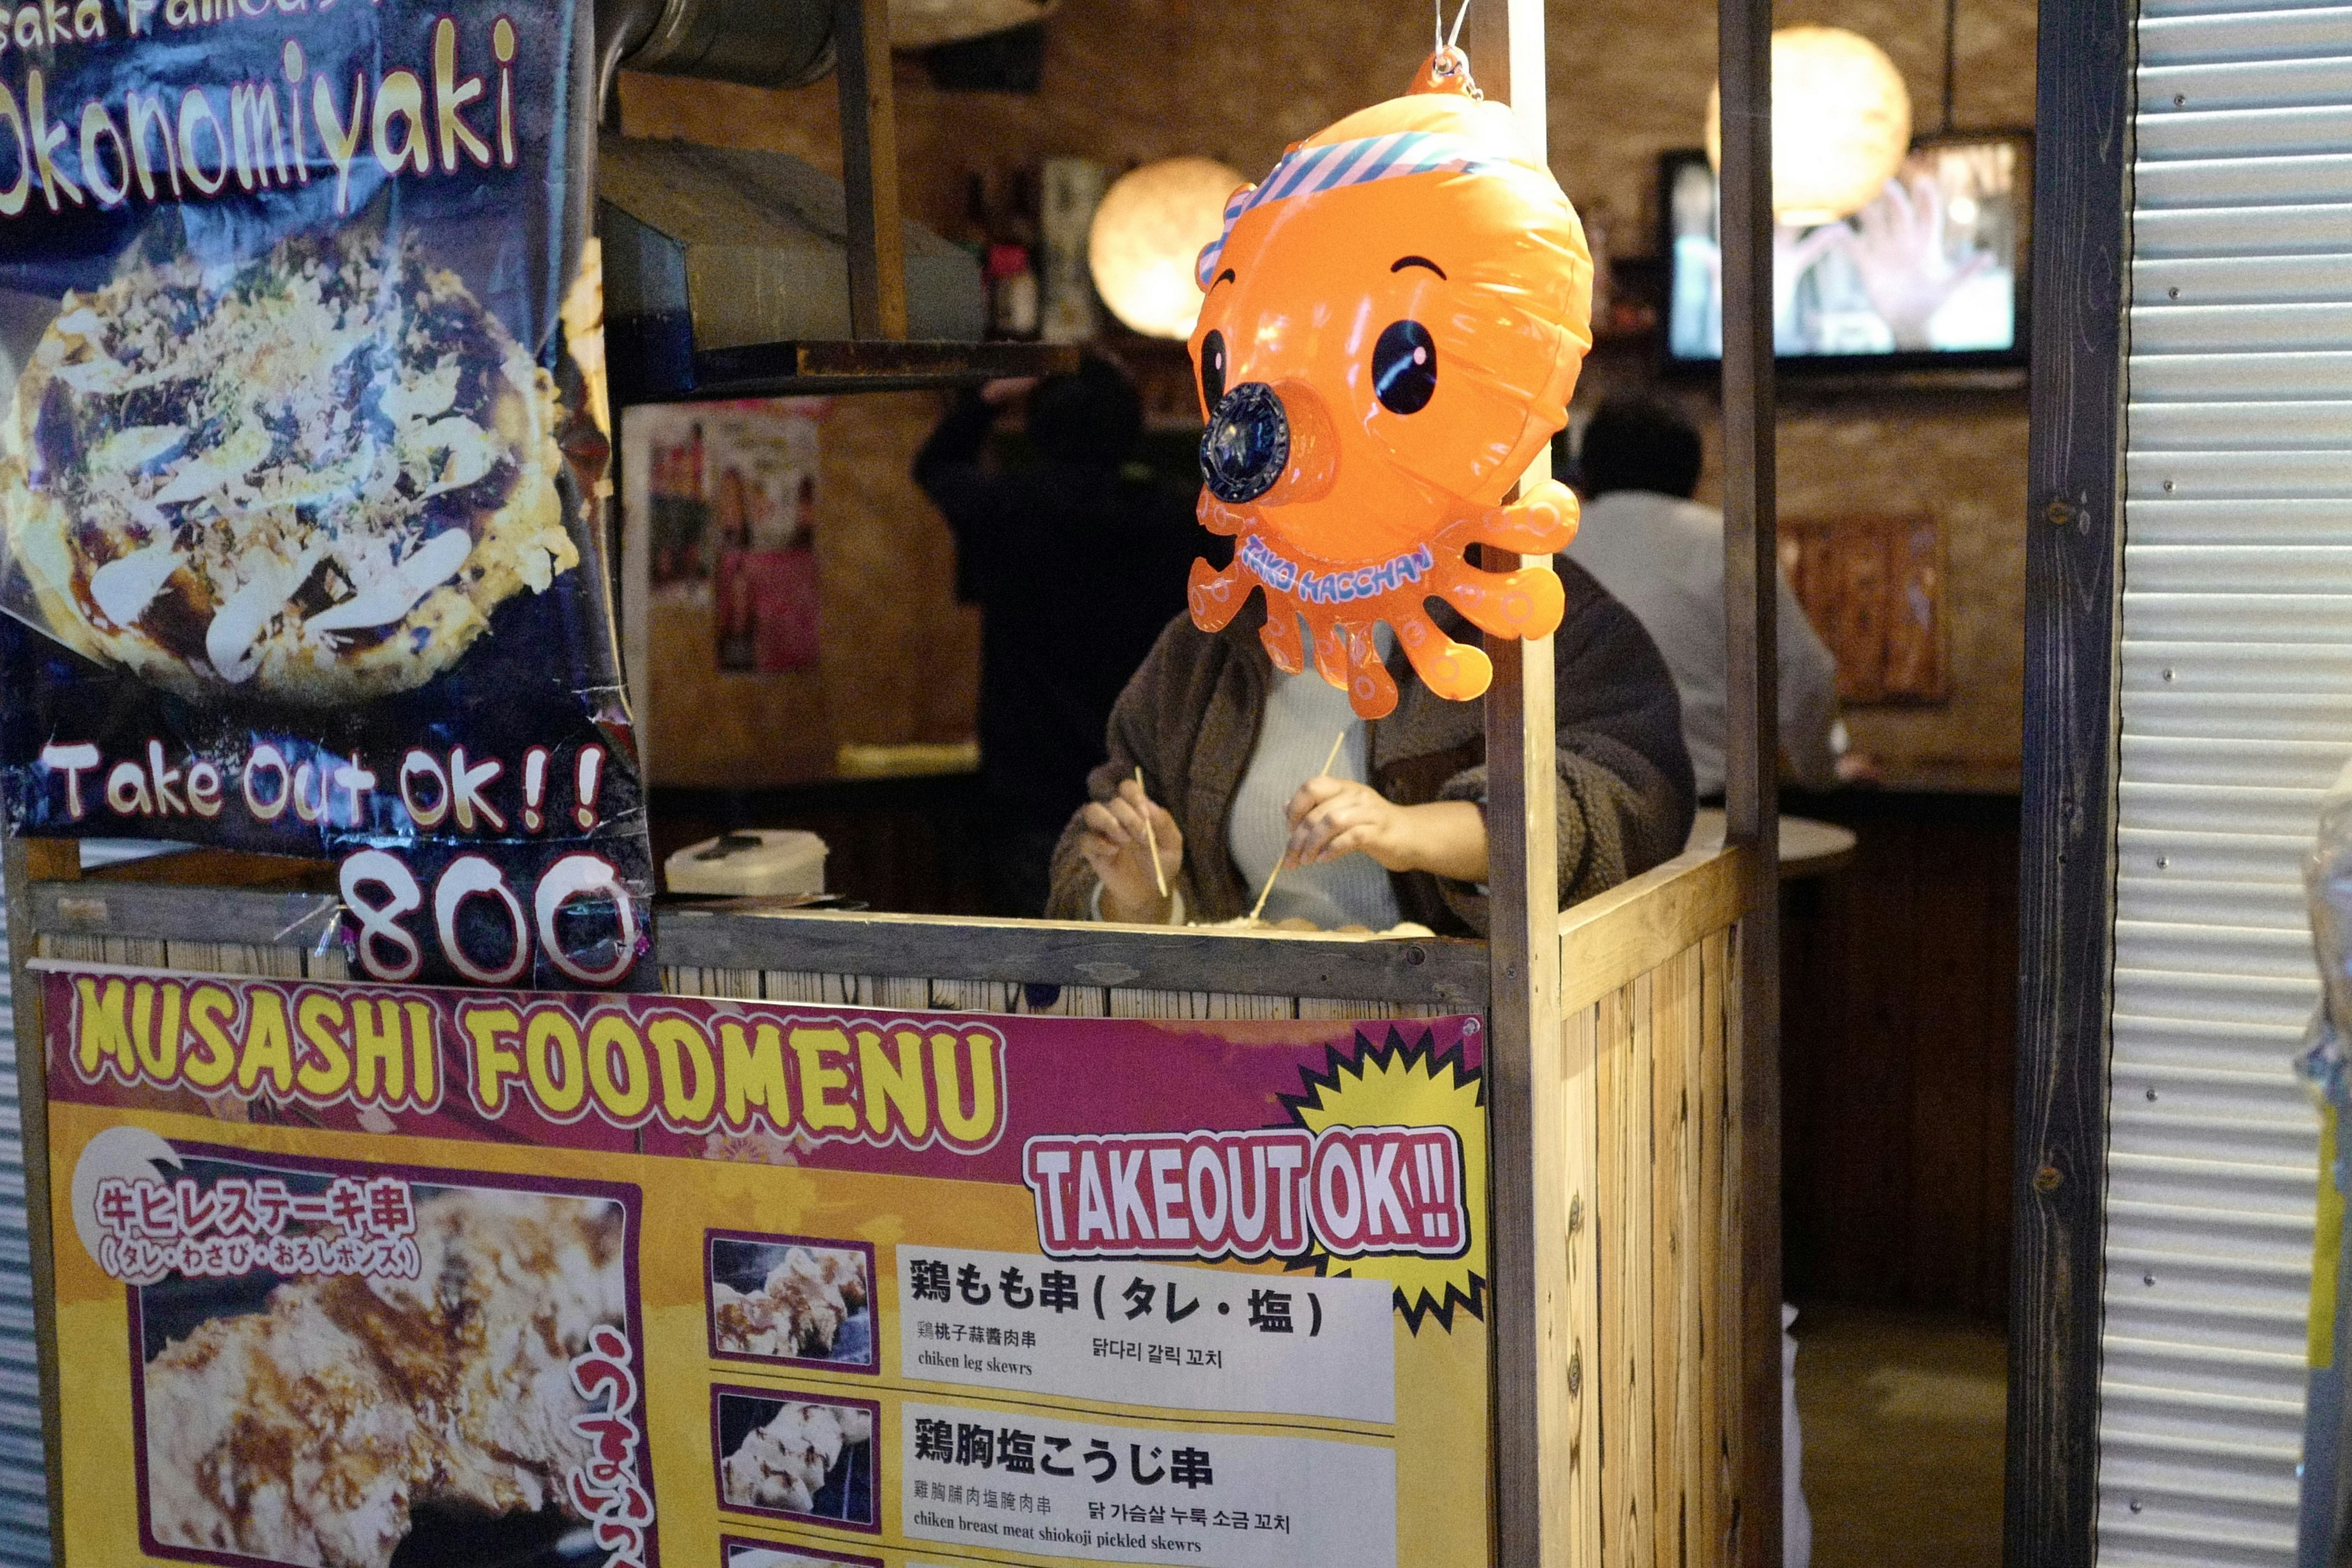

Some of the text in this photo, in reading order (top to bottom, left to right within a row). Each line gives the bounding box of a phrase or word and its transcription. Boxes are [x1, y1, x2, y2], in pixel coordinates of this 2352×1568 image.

[1242, 533, 1298, 592] TAKO
[41, 739, 223, 818] Take
[244, 742, 377, 825] Out
[337, 847, 636, 981] 800
[74, 976, 440, 1105] MUSASHI
[99, 1182, 413, 1236] 牛ヒレステーキ串
[1036, 1144, 1302, 1242] TAKEOUT
[918, 1350, 1032, 1376] chiken leg skewrs
[1092, 1338, 1223, 1369] 닭다리 갈릭 꼬치
[914, 1418, 1213, 1490] 鶏胸塩こうじ串
[913, 1510, 1202, 1553] chiken breast meat shiokoji pickled skewrs
[1088, 1501, 1291, 1534] 닭 가슴살 누룩 소금 꼬치
